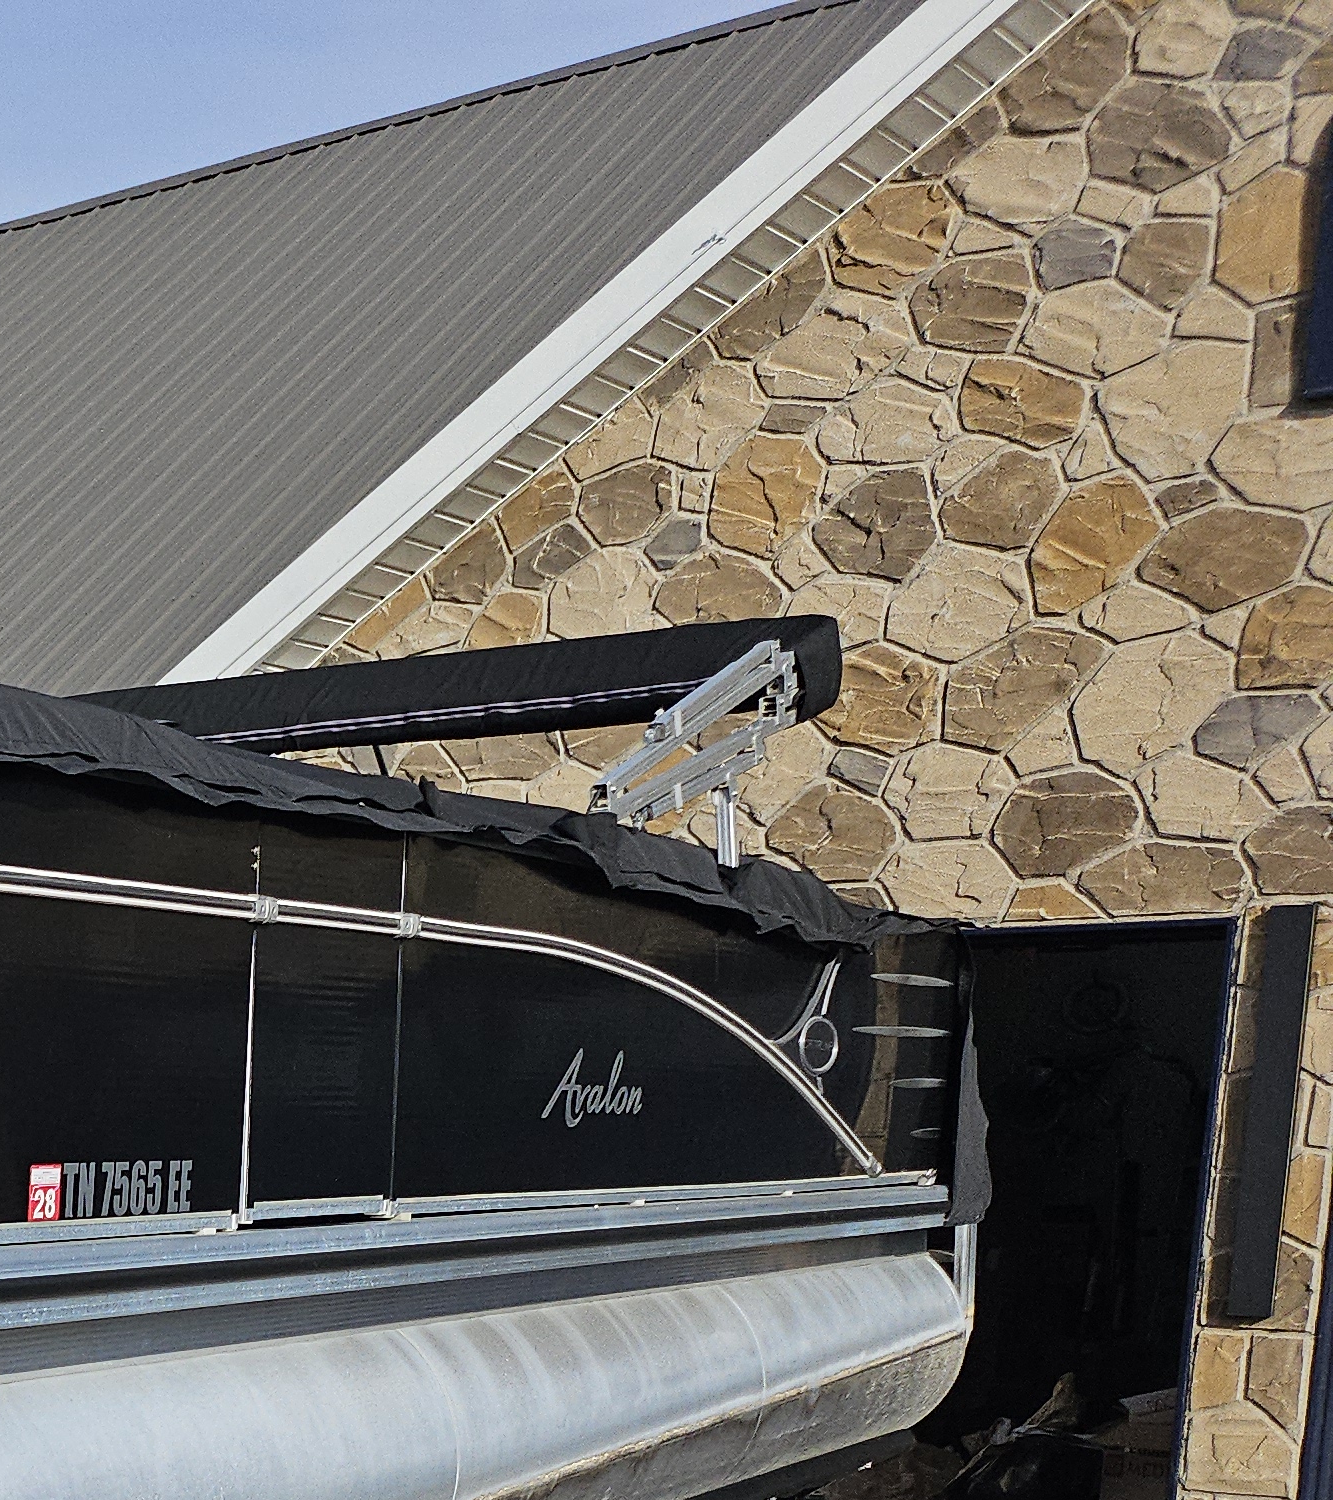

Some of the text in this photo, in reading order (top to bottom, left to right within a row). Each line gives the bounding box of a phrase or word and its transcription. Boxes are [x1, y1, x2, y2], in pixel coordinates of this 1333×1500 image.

[540, 1047, 643, 1128] Avalon
[33, 1188, 56, 1219] 28
[63, 1159, 193, 1218] TN 7565 EE
